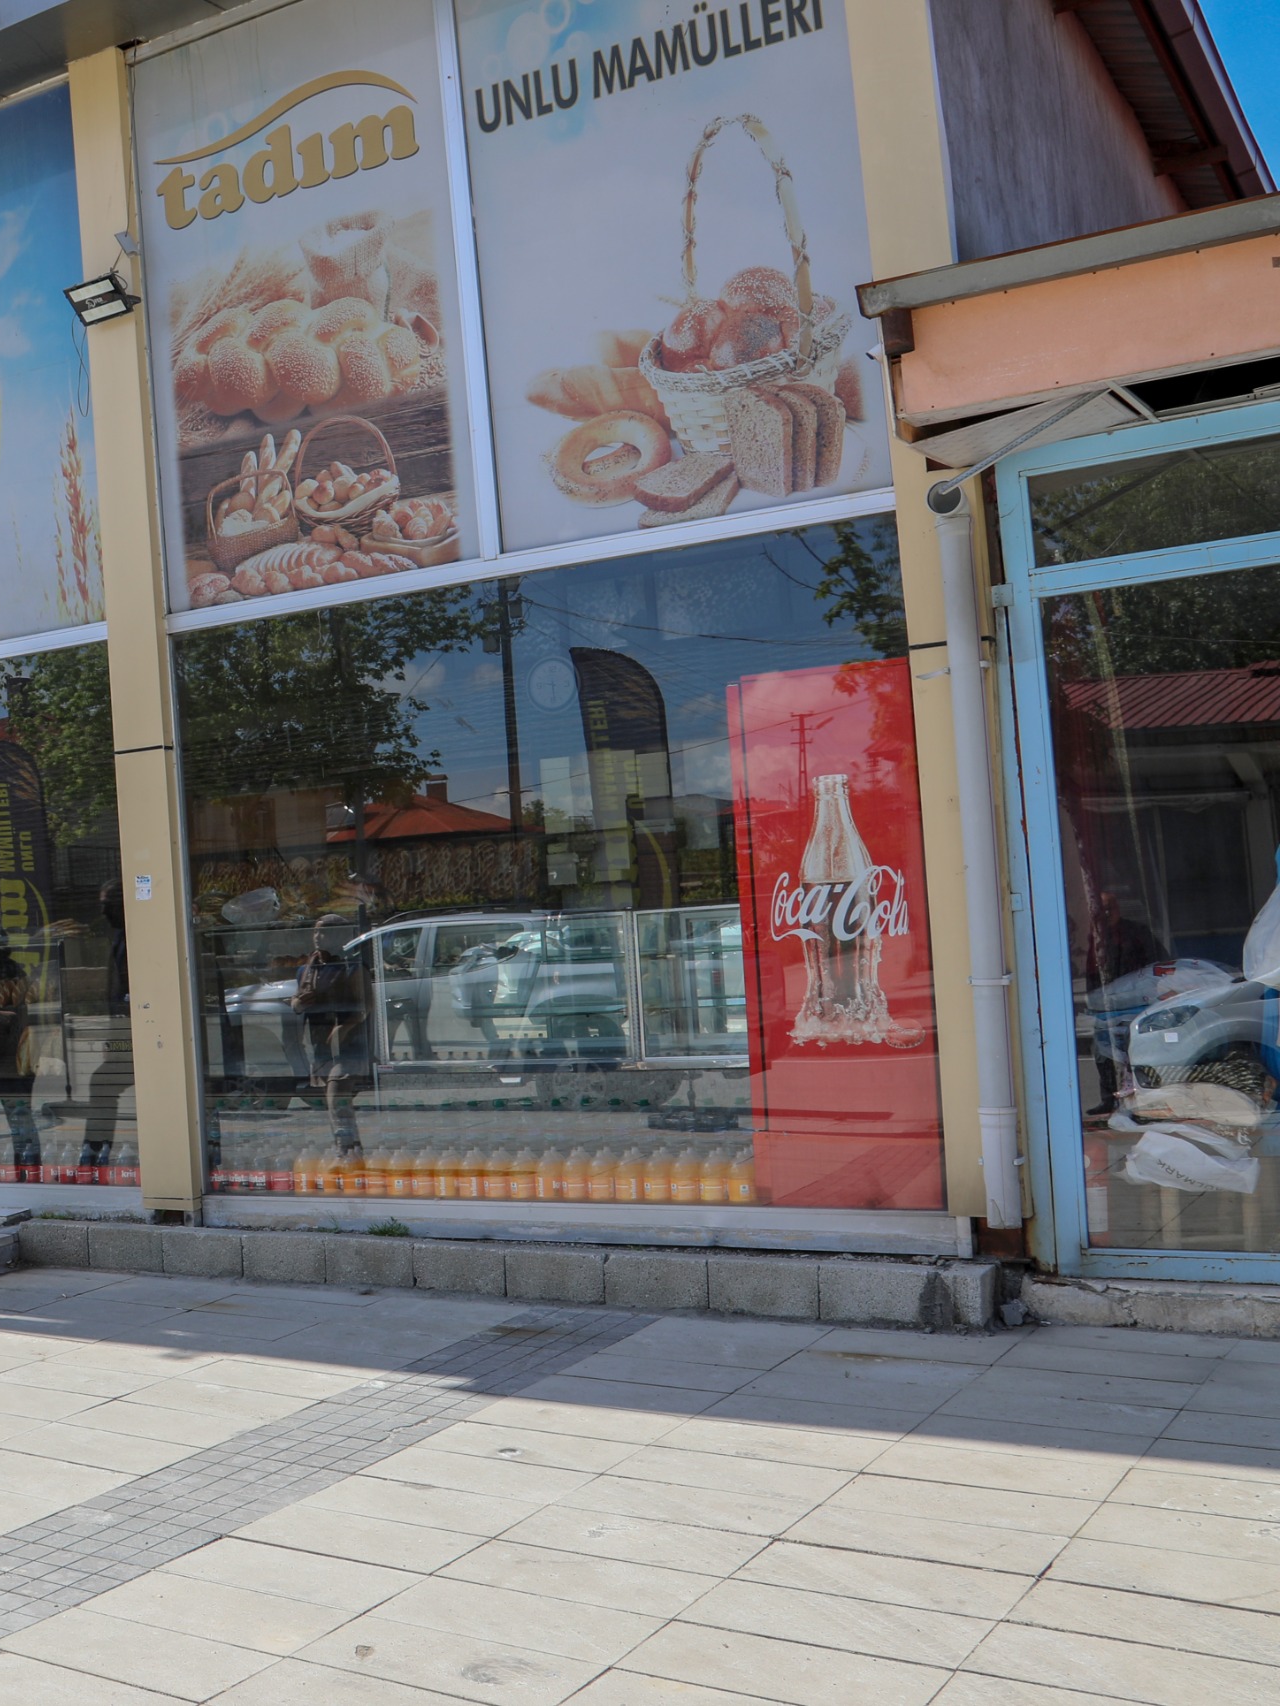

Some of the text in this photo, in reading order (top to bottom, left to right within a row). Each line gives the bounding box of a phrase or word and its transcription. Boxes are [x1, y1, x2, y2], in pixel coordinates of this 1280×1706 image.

[474, 58, 580, 133] UNLU
[156, 103, 420, 230] tadım
[771, 864, 909, 942] Coca-Cola
